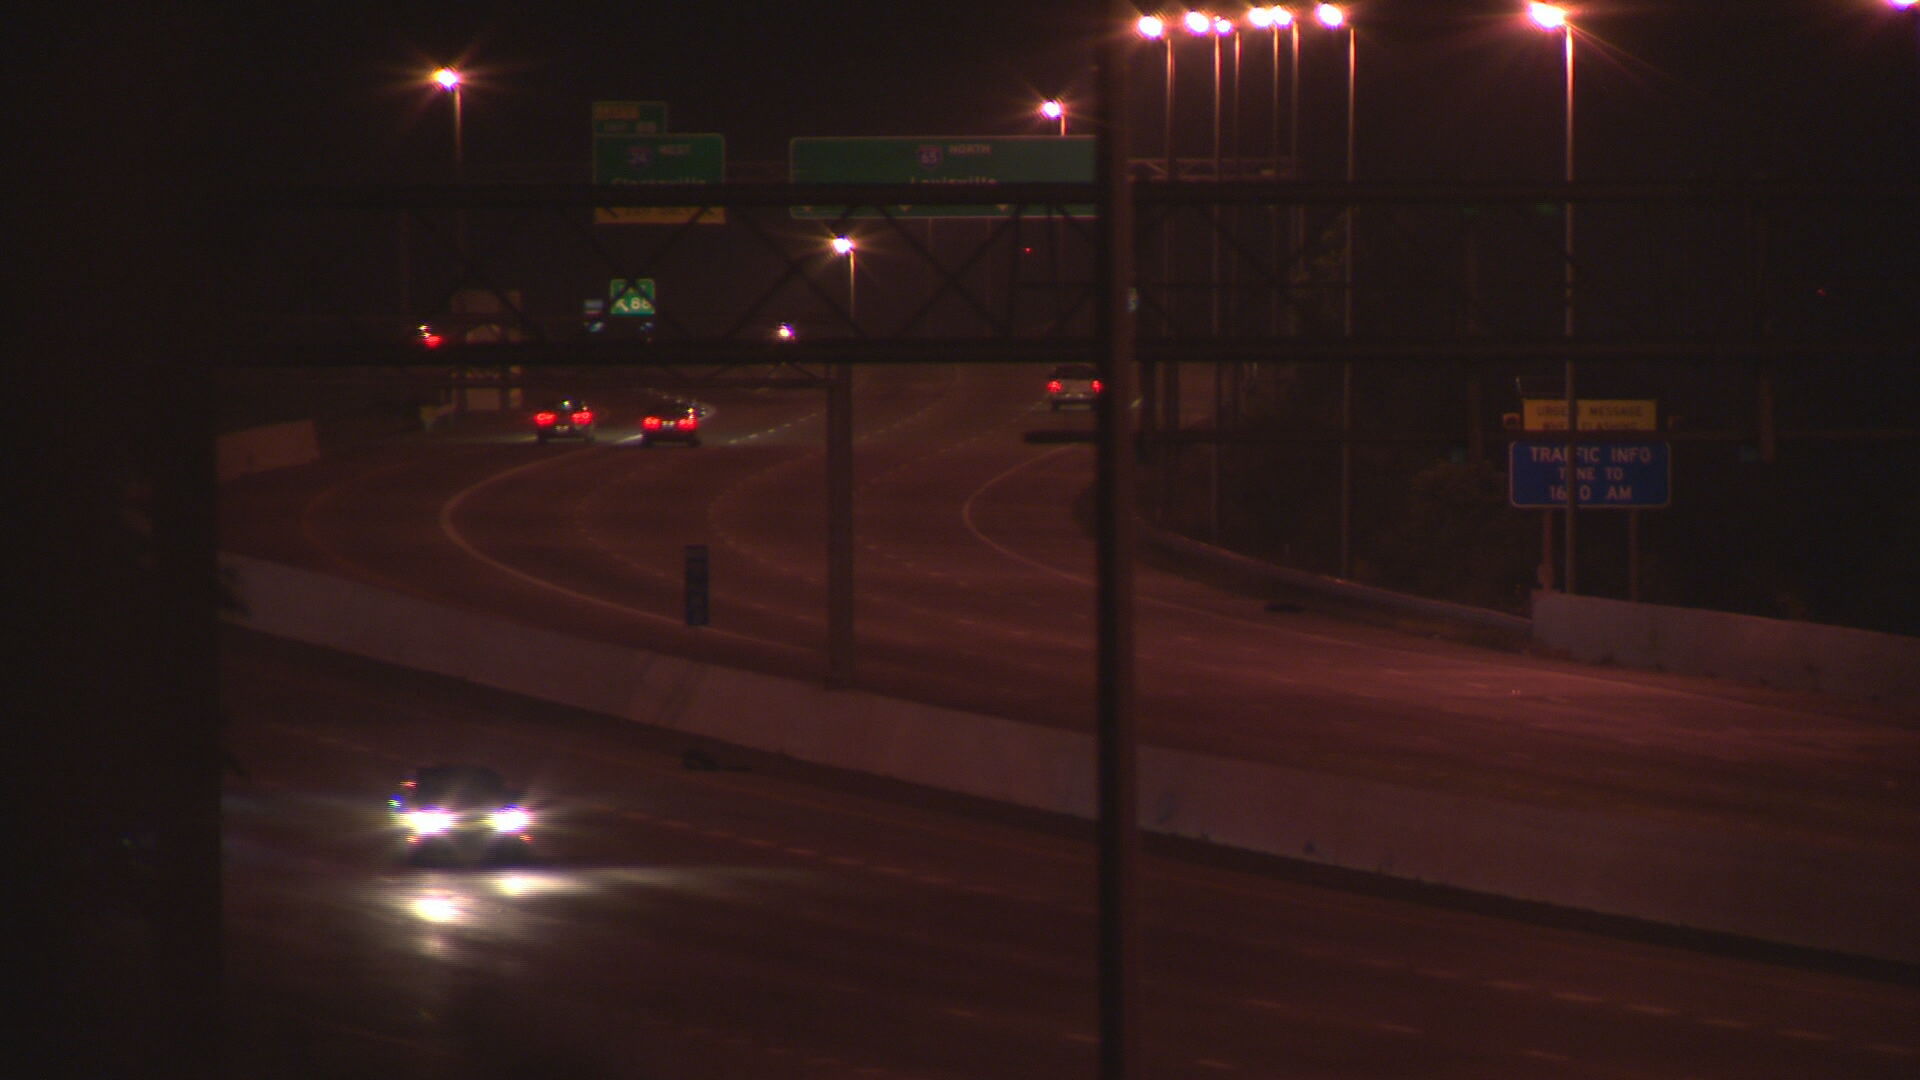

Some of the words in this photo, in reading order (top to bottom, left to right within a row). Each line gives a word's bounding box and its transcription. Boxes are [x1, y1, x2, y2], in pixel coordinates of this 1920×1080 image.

[949, 143, 991, 154] NORTH
[1536, 405, 1580, 417] URGE
[1611, 448, 1652, 463] INFO
[1558, 467, 1596, 481] TNE
[1604, 466, 1624, 481] TO
[1549, 485, 1591, 500] 160
[1605, 484, 1633, 500] AM
